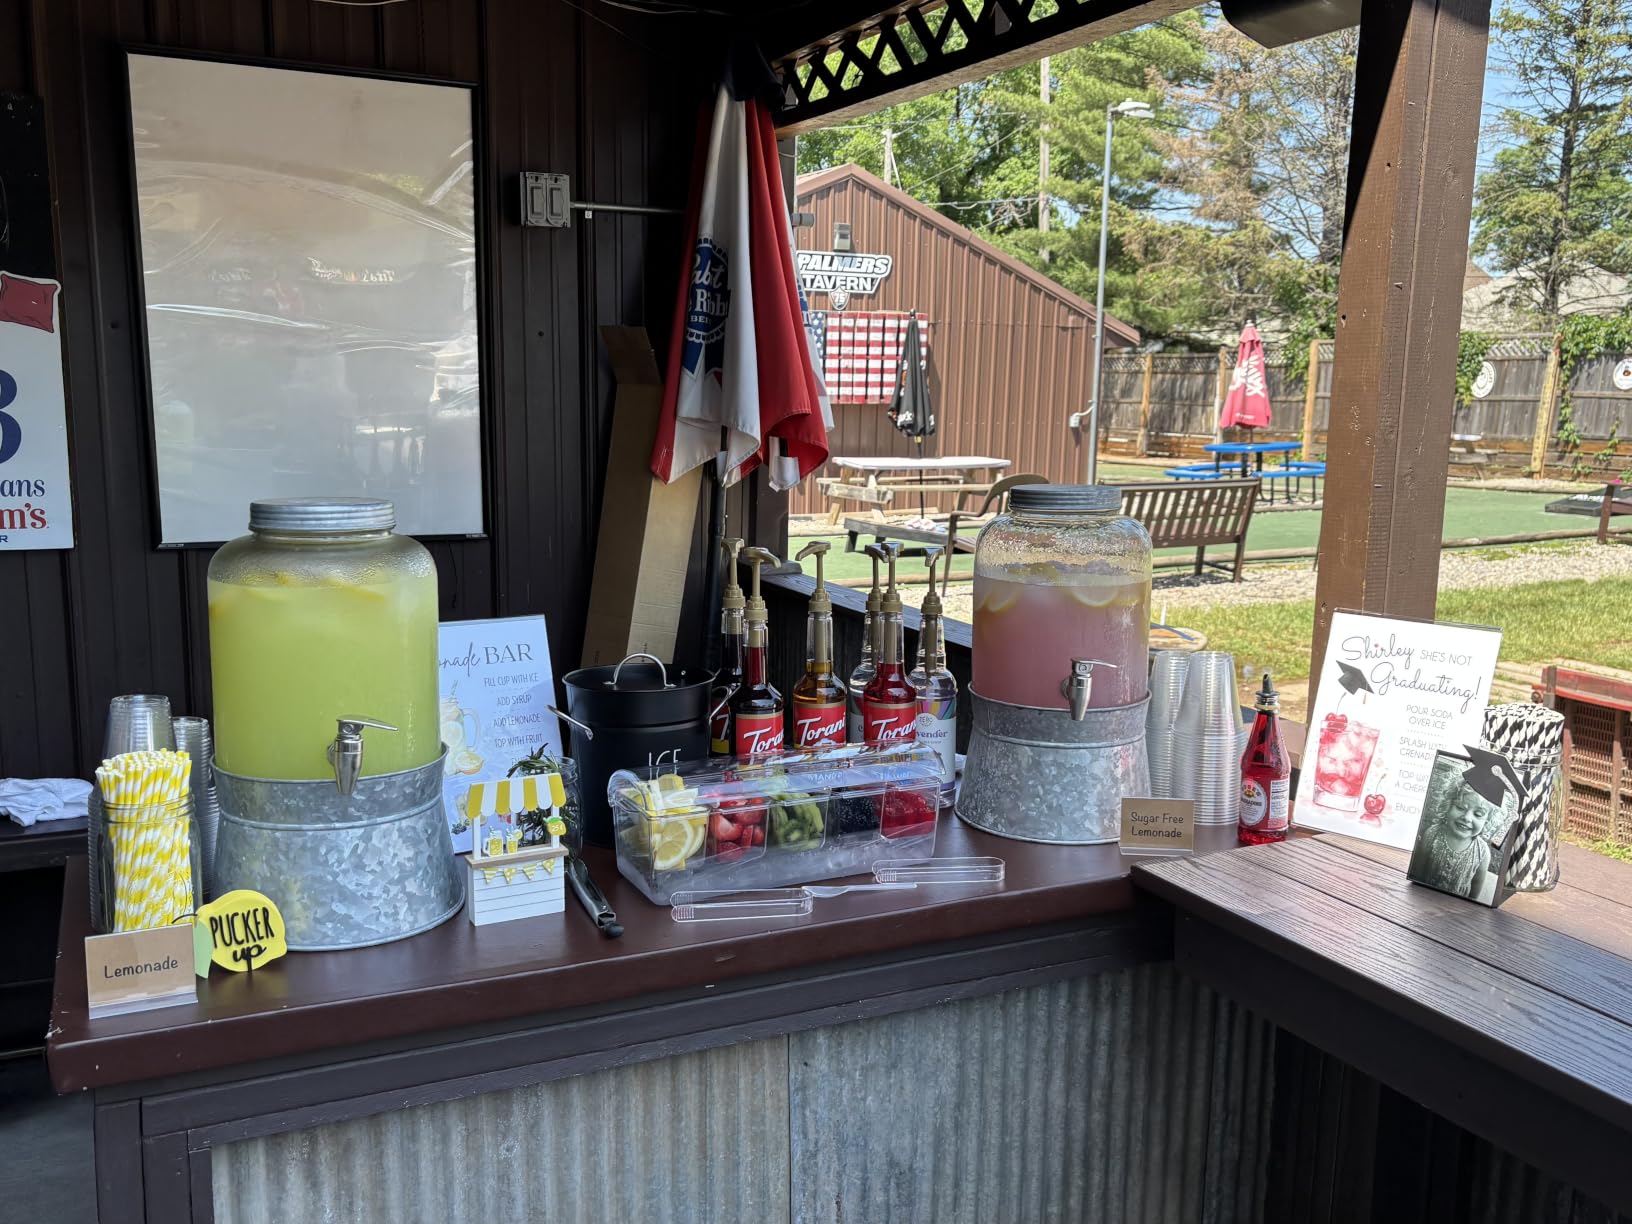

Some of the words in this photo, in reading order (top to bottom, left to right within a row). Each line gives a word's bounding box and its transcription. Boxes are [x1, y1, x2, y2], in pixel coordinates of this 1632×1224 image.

[798, 254, 888, 274] PALMERS
[802, 274, 872, 291] TAVERN
[438, 641, 481, 677] nade
[483, 643, 534, 665] BAR
[1341, 633, 1415, 670] Shirley
[1420, 649, 1446, 663] SHE'S
[1448, 653, 1473, 666] NOT
[483, 676, 496, 688] FILL
[497, 675, 511, 686] CUP
[511, 674, 529, 685] WITH
[529, 672, 540, 683] ICE
[1370, 661, 1482, 714] Graduating!
[497, 696, 511, 707] ADD
[511, 694, 532, 706] SYRUP
[1406, 704, 1429, 716] POUR
[1431, 708, 1453, 720] SODA
[493, 716, 508, 728] ADD
[508, 713, 542, 726] LEMONADE
[1408, 715, 1431, 727] OVER
[1432, 720, 1447, 730] ICE
[797, 712, 846, 747] Torani
[494, 737, 507, 749] TOP
[507, 735, 525, 748] WITH
[525, 733, 543, 745] FRUIT
[1399, 736, 1427, 750] SPLASH
[1398, 769, 1415, 780] TOP
[1394, 780, 1400, 789] A
[1130, 811, 1160, 826] Sugar
[1162, 812, 1184, 824] Free
[1131, 825, 1183, 838] Lemonade
[209, 906, 275, 949] PUCKER
[232, 943, 268, 969] up
[104, 955, 179, 979] Lemonade
